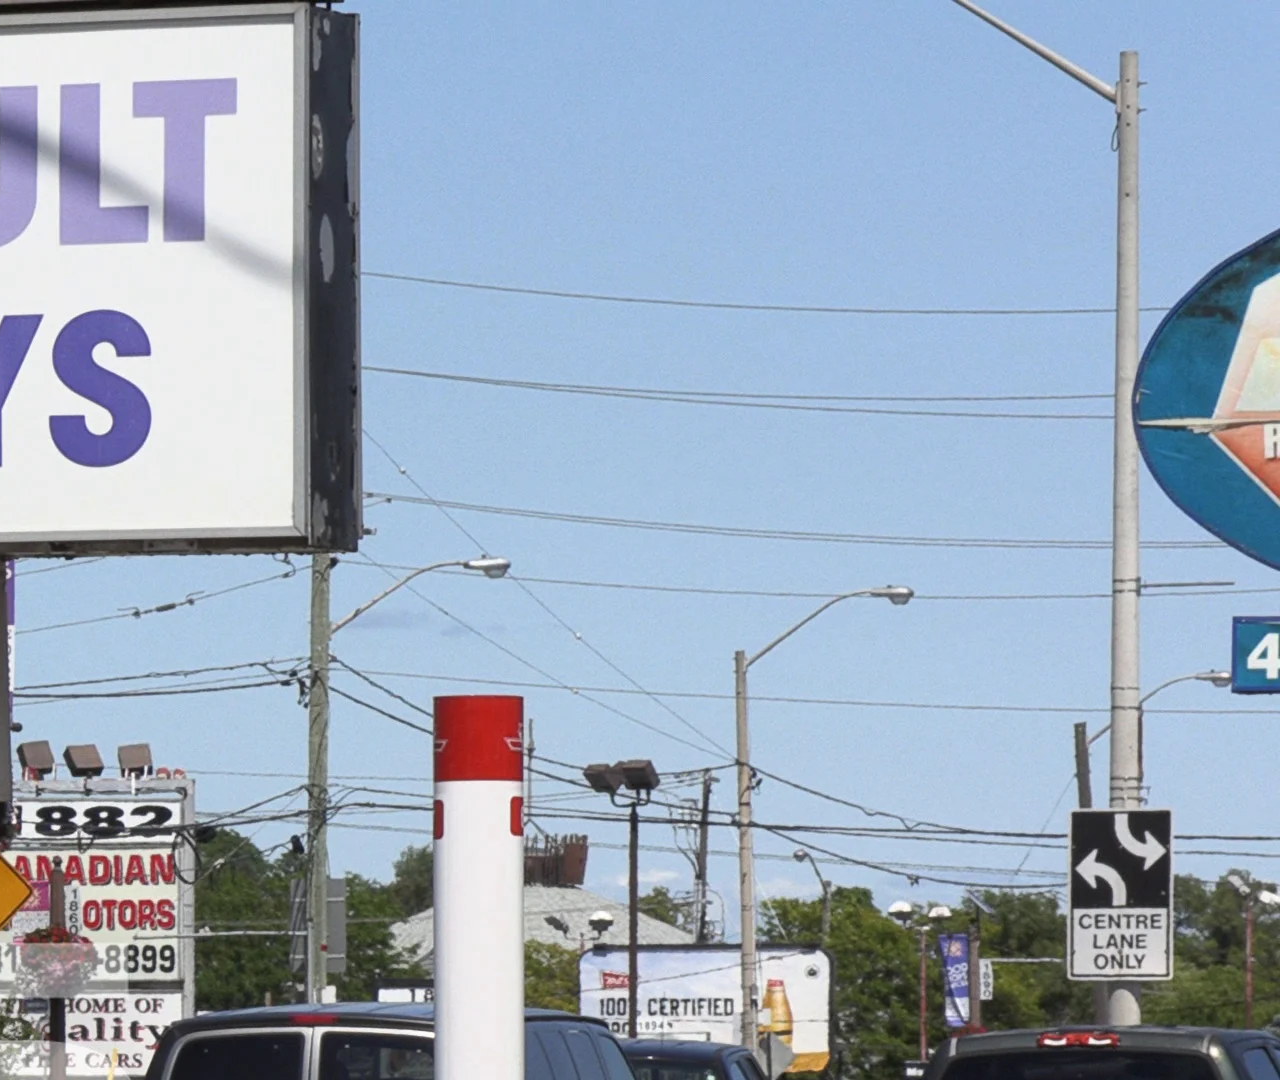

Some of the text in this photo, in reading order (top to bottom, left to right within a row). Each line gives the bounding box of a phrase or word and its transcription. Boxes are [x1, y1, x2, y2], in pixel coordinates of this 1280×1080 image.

[1078, 913, 1163, 930] CENTRE
[1092, 933, 1148, 950] LANE
[1093, 953, 1146, 970] ONLY
[134, 997, 165, 1014] OF
[647, 997, 735, 1017] CERTIFIED
